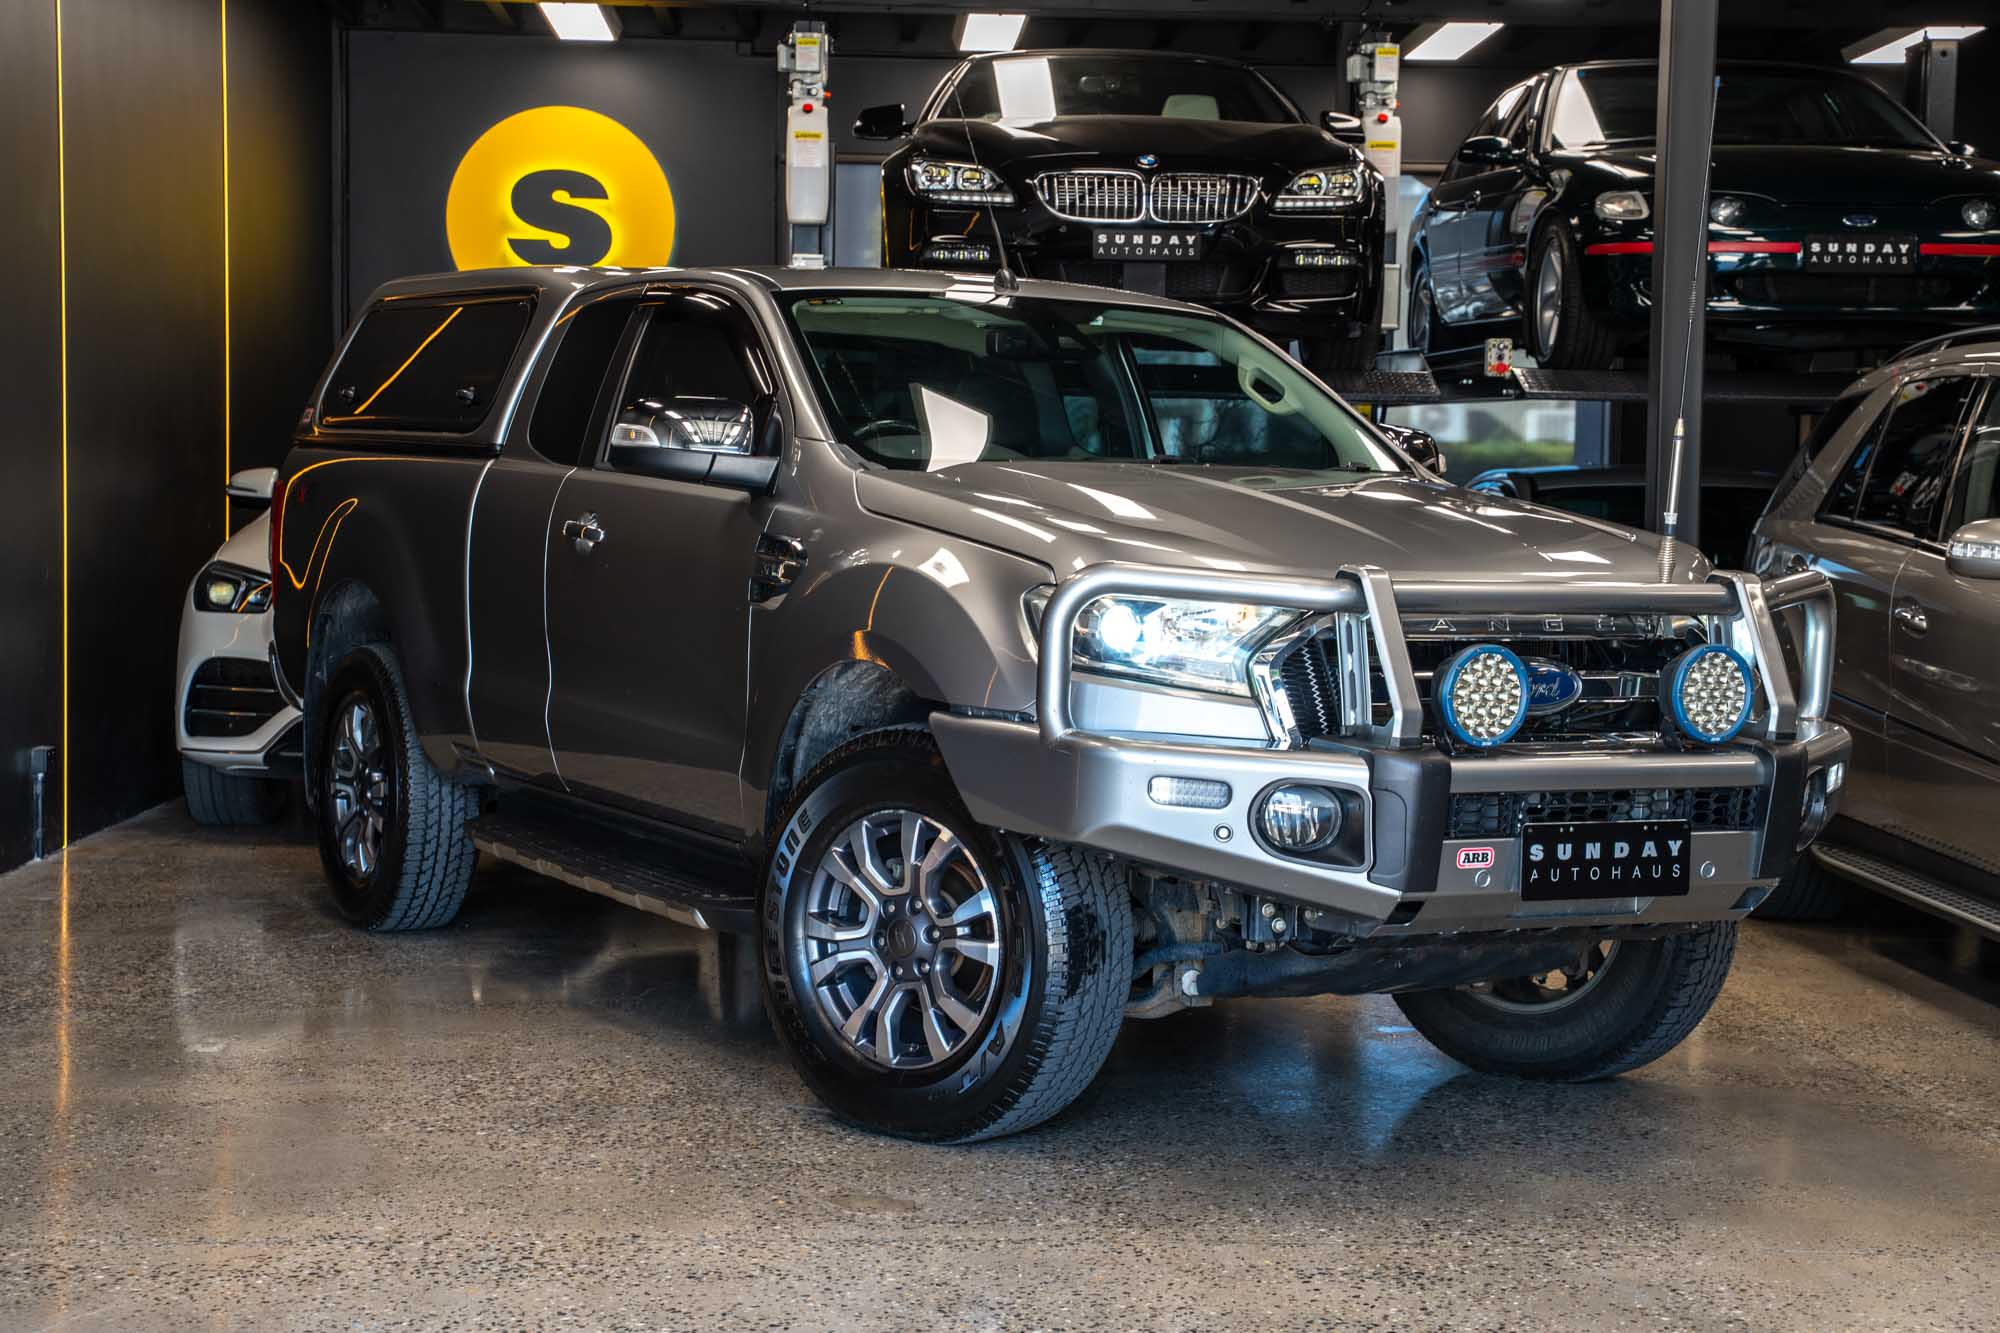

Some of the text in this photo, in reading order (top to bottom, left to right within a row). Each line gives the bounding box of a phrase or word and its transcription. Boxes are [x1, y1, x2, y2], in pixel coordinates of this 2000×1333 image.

[506, 168, 613, 266] S
[1098, 234, 1196, 244] SUNDAY
[1098, 247, 1195, 256] AUTOHAUS
[1811, 243, 1910, 253] SUNDAY
[1811, 255, 1908, 264] AUTOHAUS
[1529, 839, 1684, 862] SUNDAY
[1462, 852, 1490, 863] ARB
[1529, 863, 1682, 883] AUTOHAUS
